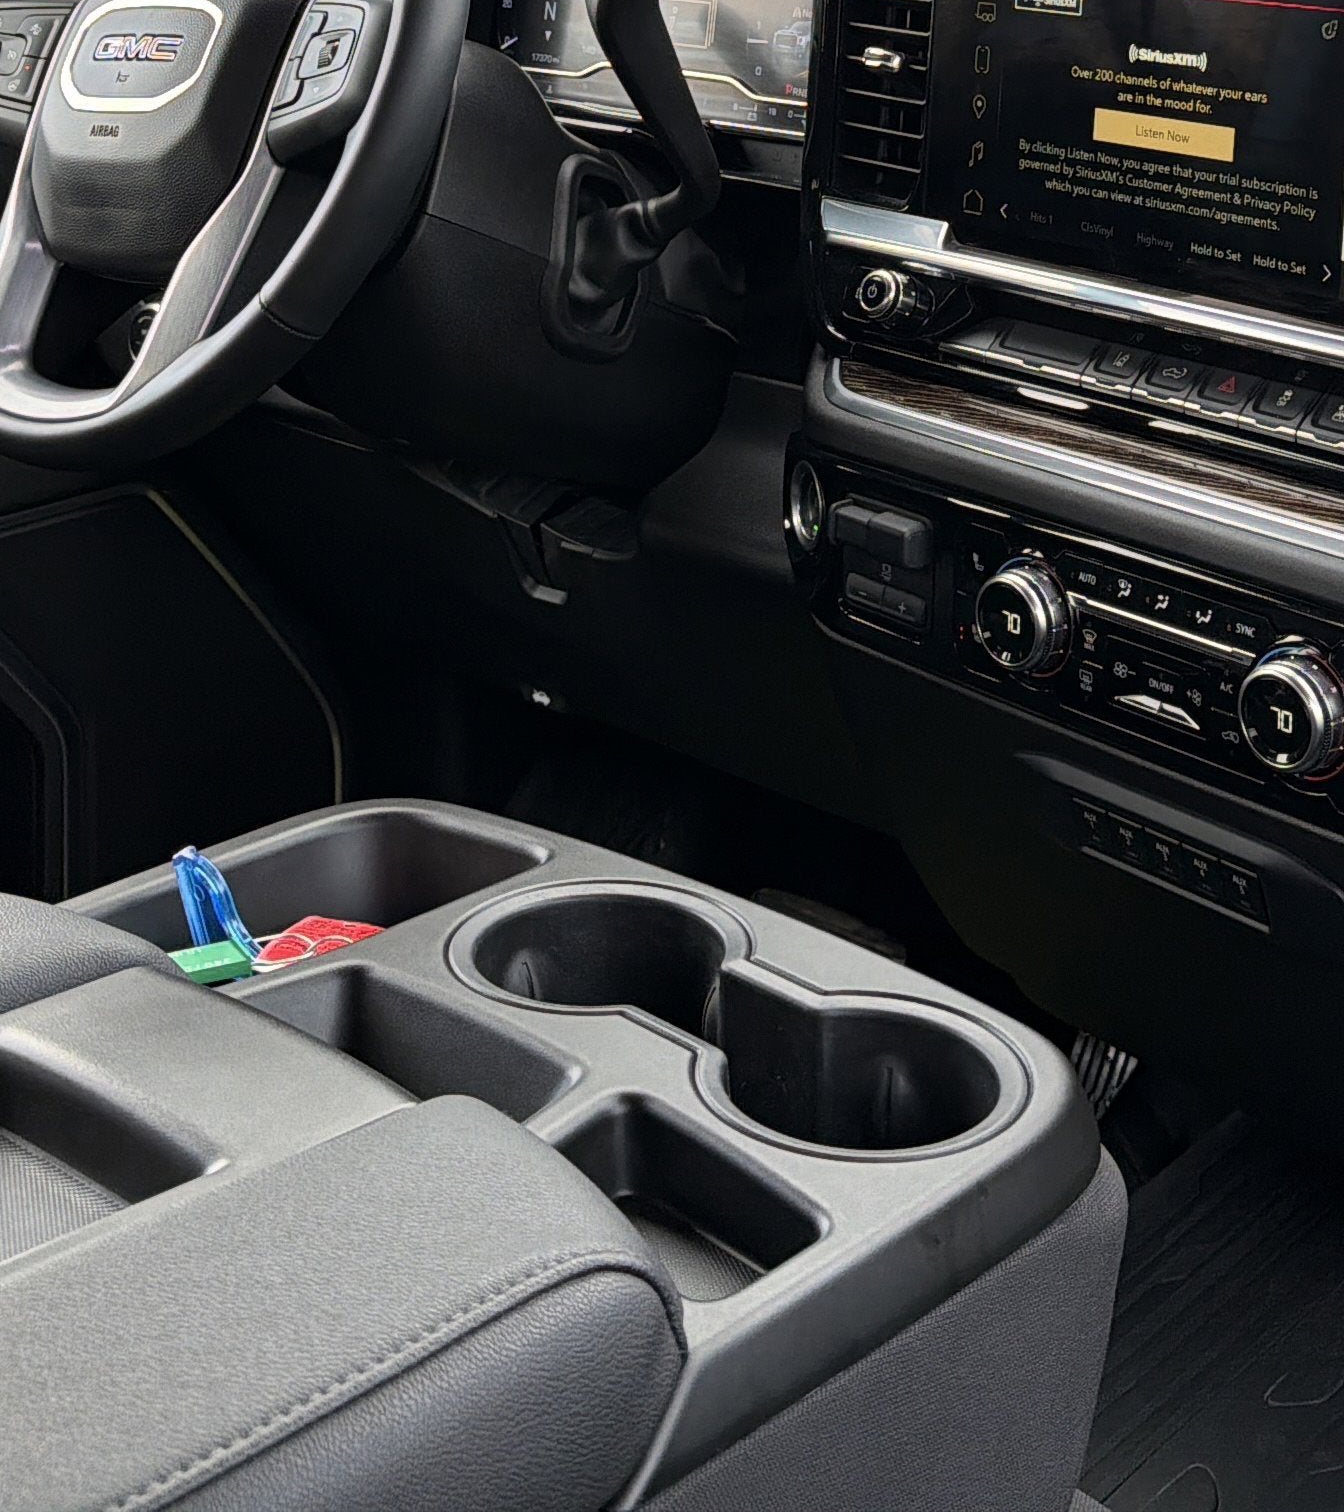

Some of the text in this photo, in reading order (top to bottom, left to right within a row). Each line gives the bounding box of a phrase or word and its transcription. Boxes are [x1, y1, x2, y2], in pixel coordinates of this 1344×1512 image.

[544, 1, 556, 22] N
[93, 33, 184, 62] GMC
[1137, 47, 1200, 68] SiriusXM
[1071, 66, 1268, 104] Over 200 channels of whatever your ears
[1117, 92, 1213, 114] are in the mood for.
[89, 124, 120, 138] AIRBAG
[1135, 125, 1190, 144] Listen Now
[1019, 139, 1319, 200] By clicking Listen Now, you agree that your trial subscription is
[1018, 158, 1316, 222] governed by SiriusXM's Customer Agreement & Privacy Policy
[1045, 178, 1282, 232] which you can view at siriusxm.com/agreements.
[1136, 231, 1174, 252] Highway
[1190, 242, 1242, 264] Hold to Set
[1252, 254, 1307, 276] Hold to Set
[1078, 571, 1097, 586] AUTO
[1002, 610, 1021, 634] 70
[1235, 622, 1256, 638] SYNC
[1148, 678, 1174, 694] ON/OFF
[1220, 681, 1234, 695] A/C
[1270, 706, 1294, 734] 70
